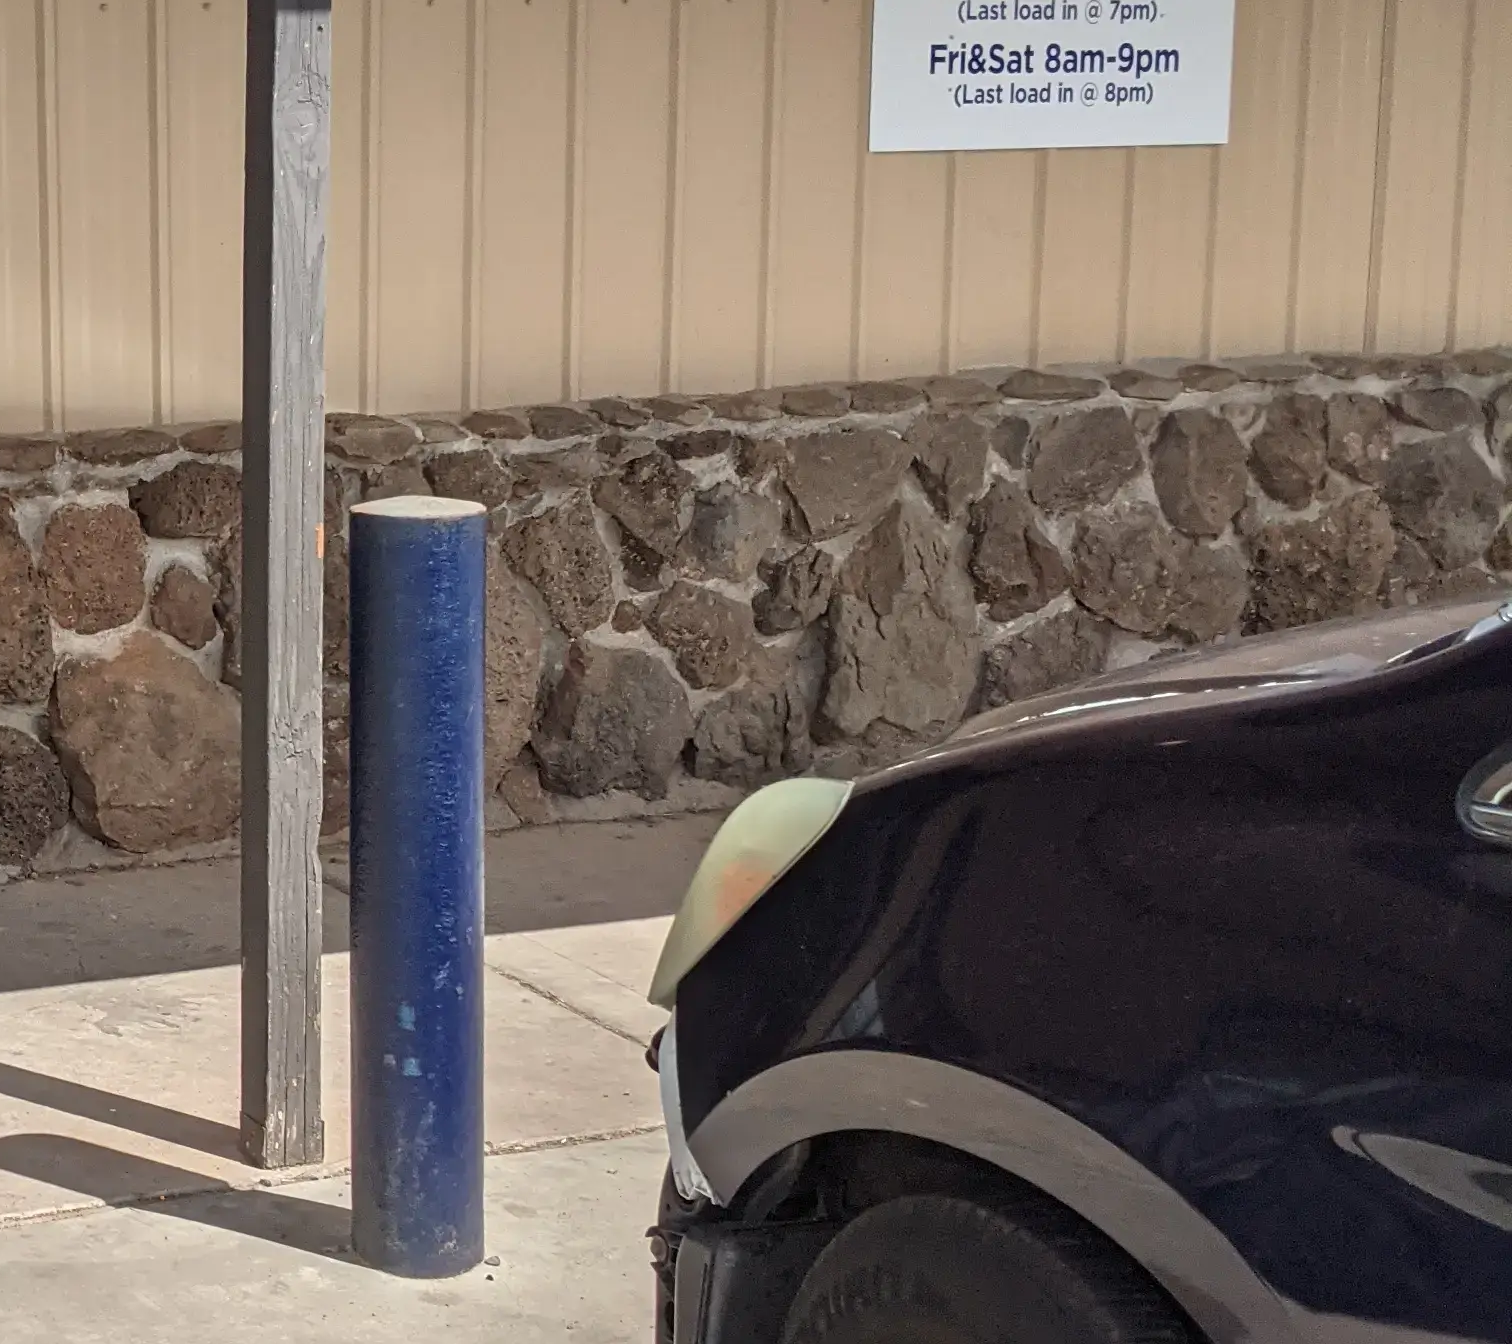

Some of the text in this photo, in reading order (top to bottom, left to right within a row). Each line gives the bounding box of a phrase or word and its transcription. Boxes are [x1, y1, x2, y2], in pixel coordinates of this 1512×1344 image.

[958, 0, 1157, 24] (Last load in @ 7pm)
[930, 43, 1179, 79] Fri&Sat 8am-9pm
[954, 82, 1153, 107] (Last load in @ 8pm)
